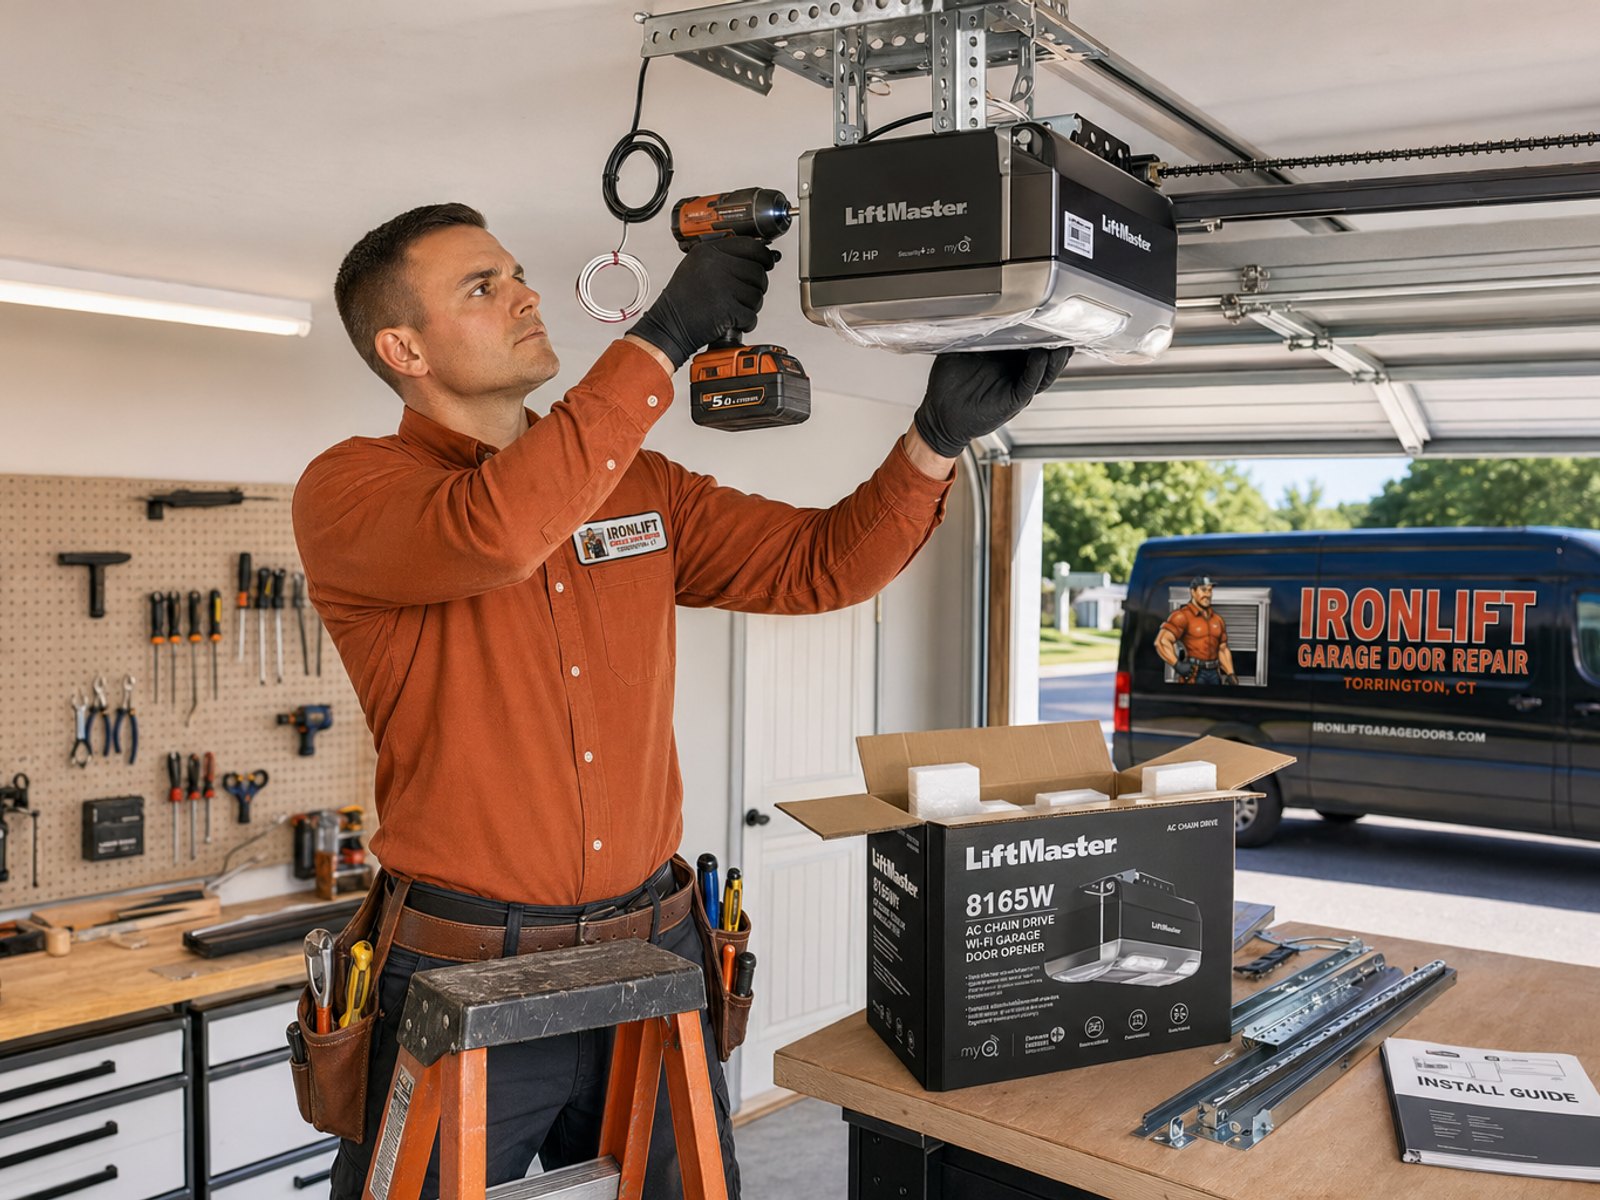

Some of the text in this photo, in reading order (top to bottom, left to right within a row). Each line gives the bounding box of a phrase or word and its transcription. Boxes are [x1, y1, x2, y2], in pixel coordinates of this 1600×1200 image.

[845, 200, 968, 226] LiftMaster
[1102, 213, 1152, 252] LiftMaster
[841, 249, 879, 263] 1/2 HP
[606, 519, 658, 540] IRONLIFT
[1299, 587, 1537, 645] IRONLIFT
[1297, 643, 1529, 675] GARAGE DOOR REPAIR
[1343, 677, 1477, 696] TORRINGTON, CT
[1312, 721, 1486, 743] IRONLIFTGARAGEDOORS.COM
[966, 834, 1119, 871] LiftMaster
[966, 884, 1055, 917] 8165W
[965, 915, 1055, 937] AC CHAIN DRIVE
[965, 930, 1041, 949] WI-FI GARAGE
[966, 942, 1045, 963] DOOR OPENER
[1417, 1075, 1580, 1104] INSTALL GUIDE
